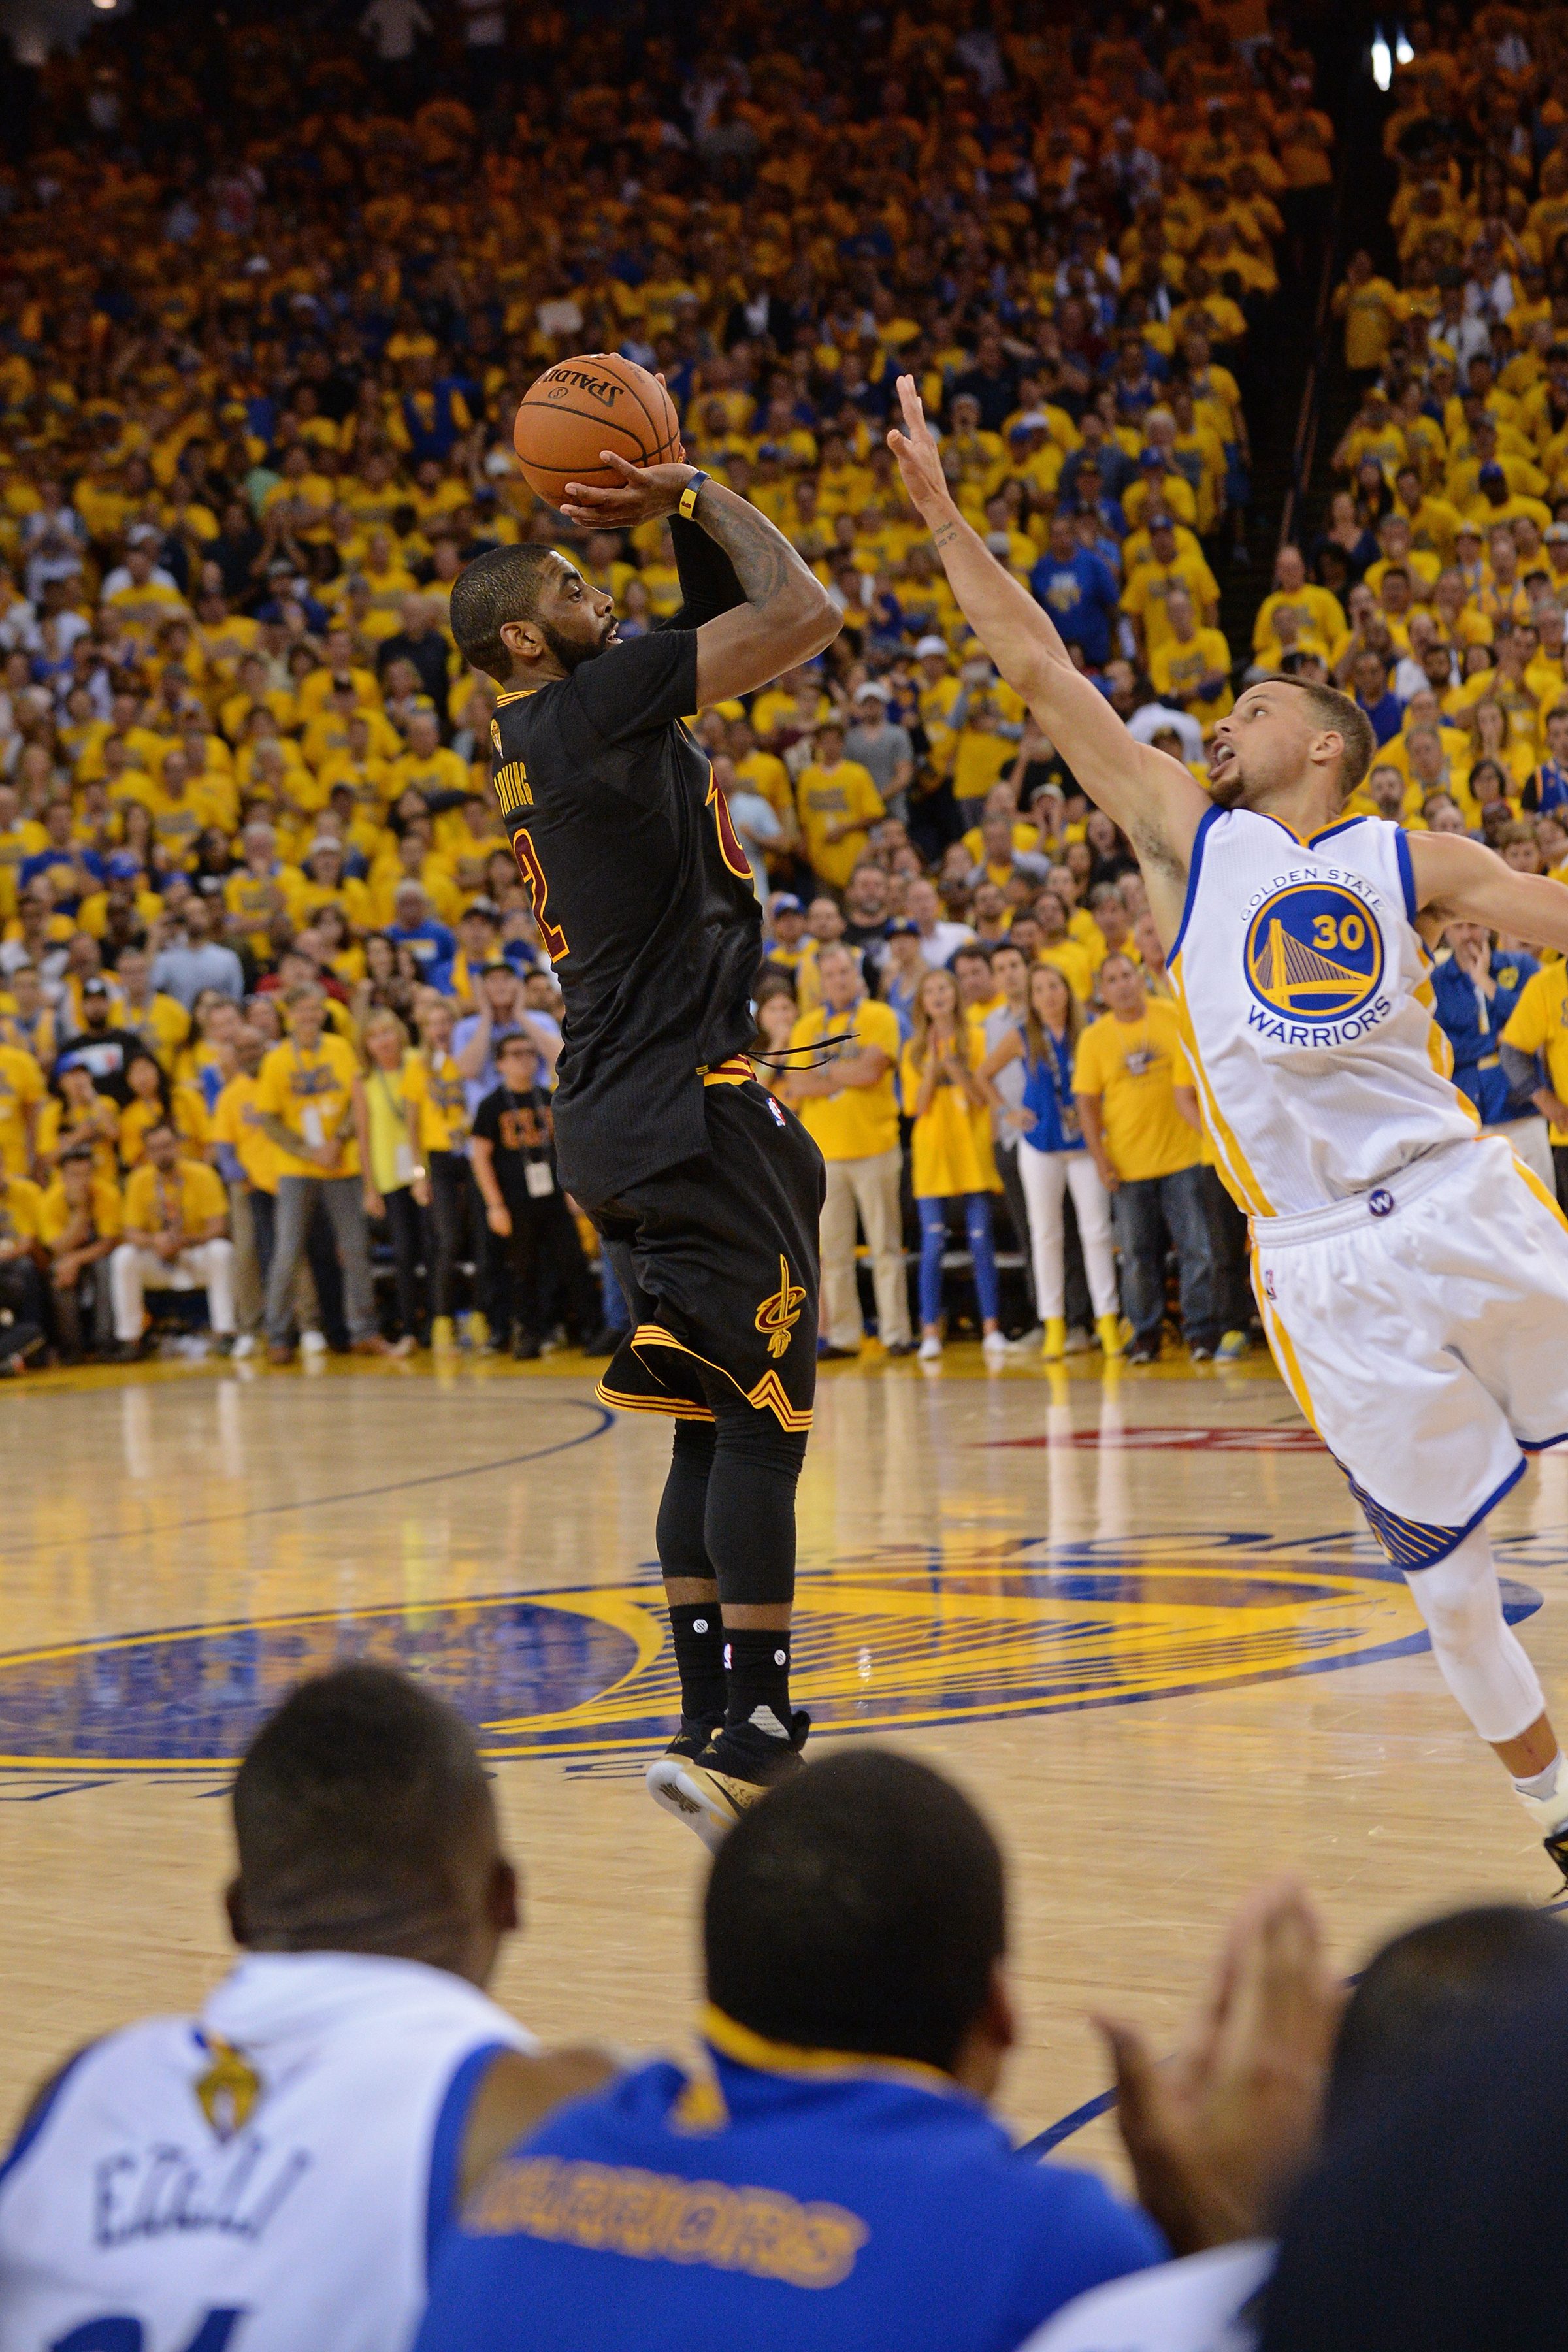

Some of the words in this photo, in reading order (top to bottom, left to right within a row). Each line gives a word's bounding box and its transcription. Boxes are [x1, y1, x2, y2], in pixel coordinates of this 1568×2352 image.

[493, 762, 534, 818] IRVING
[513, 828, 570, 963] 2
[1241, 868, 1318, 922] GOLDEN
[1327, 868, 1386, 913] STATE
[1312, 914, 1366, 951] 30
[1247, 995, 1392, 1047] WARRIORS
